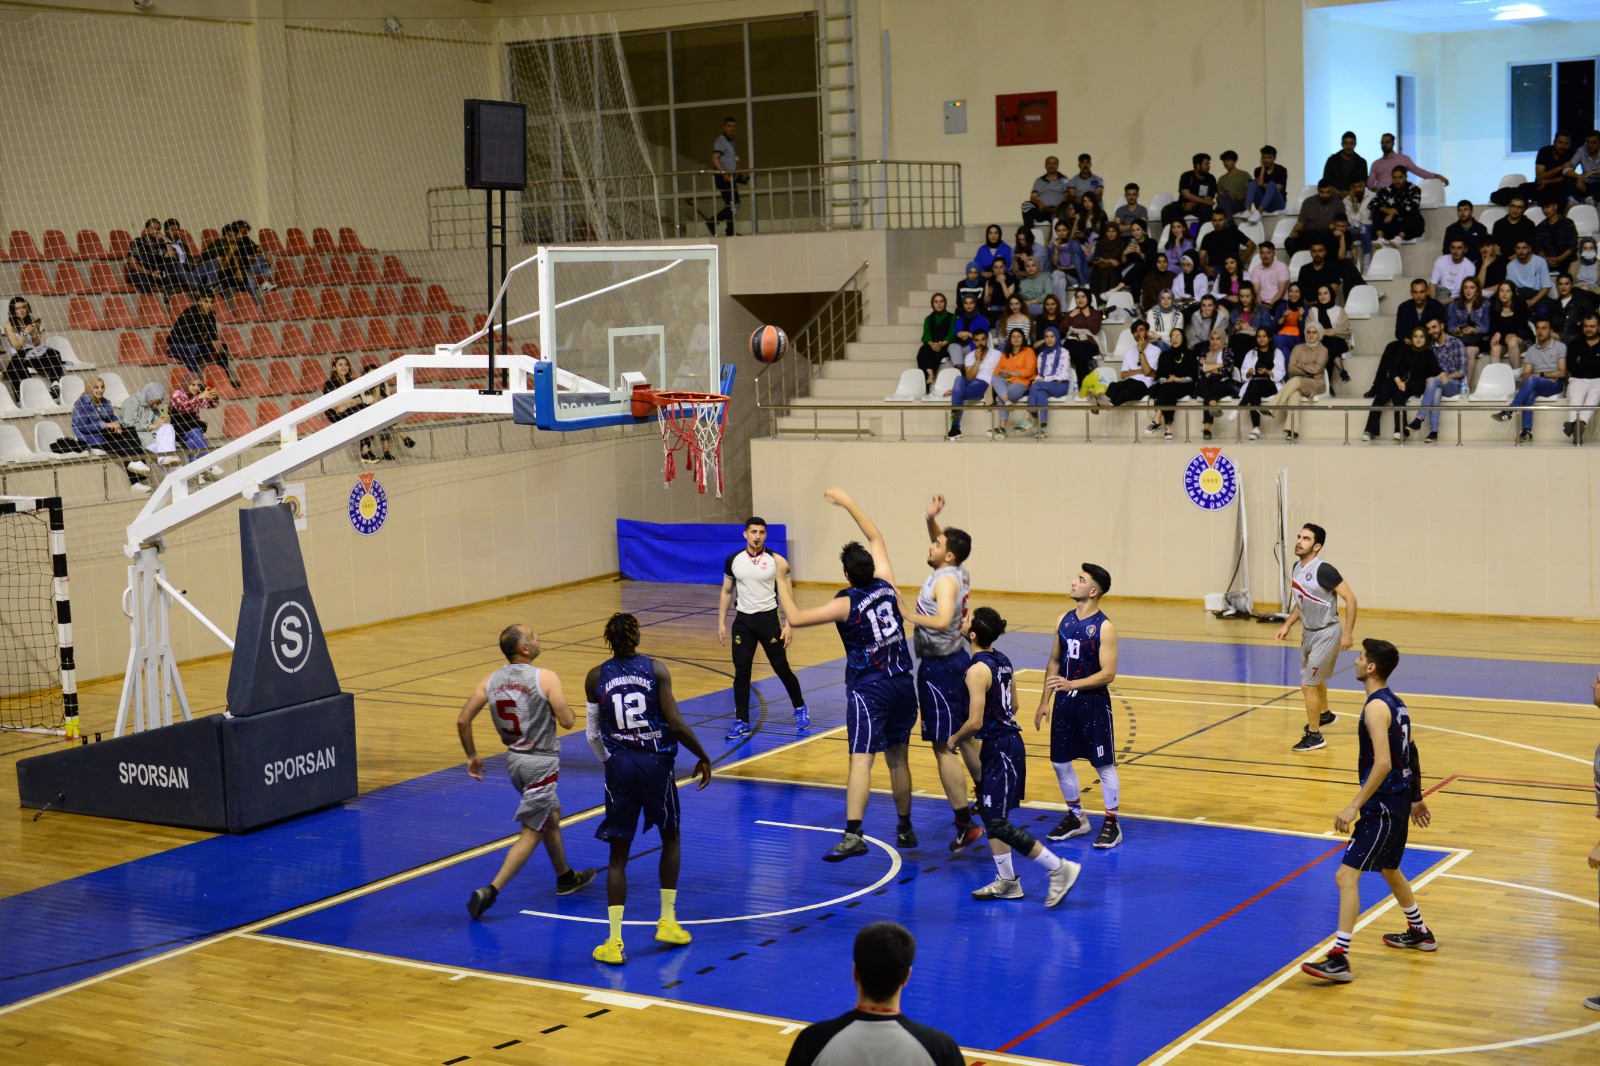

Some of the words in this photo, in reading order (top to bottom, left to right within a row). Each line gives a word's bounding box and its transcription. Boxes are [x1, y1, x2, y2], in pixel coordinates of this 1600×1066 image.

[280, 615, 303, 658] S
[866, 600, 898, 642] 13
[1067, 638, 1080, 659] 10
[1312, 667, 1319, 677] 7
[495, 699, 523, 736] 5
[612, 691, 649, 730] 12
[264, 746, 336, 785] SPORSAN
[1096, 745, 1104, 757] 10
[119, 761, 189, 789] SPORSAN
